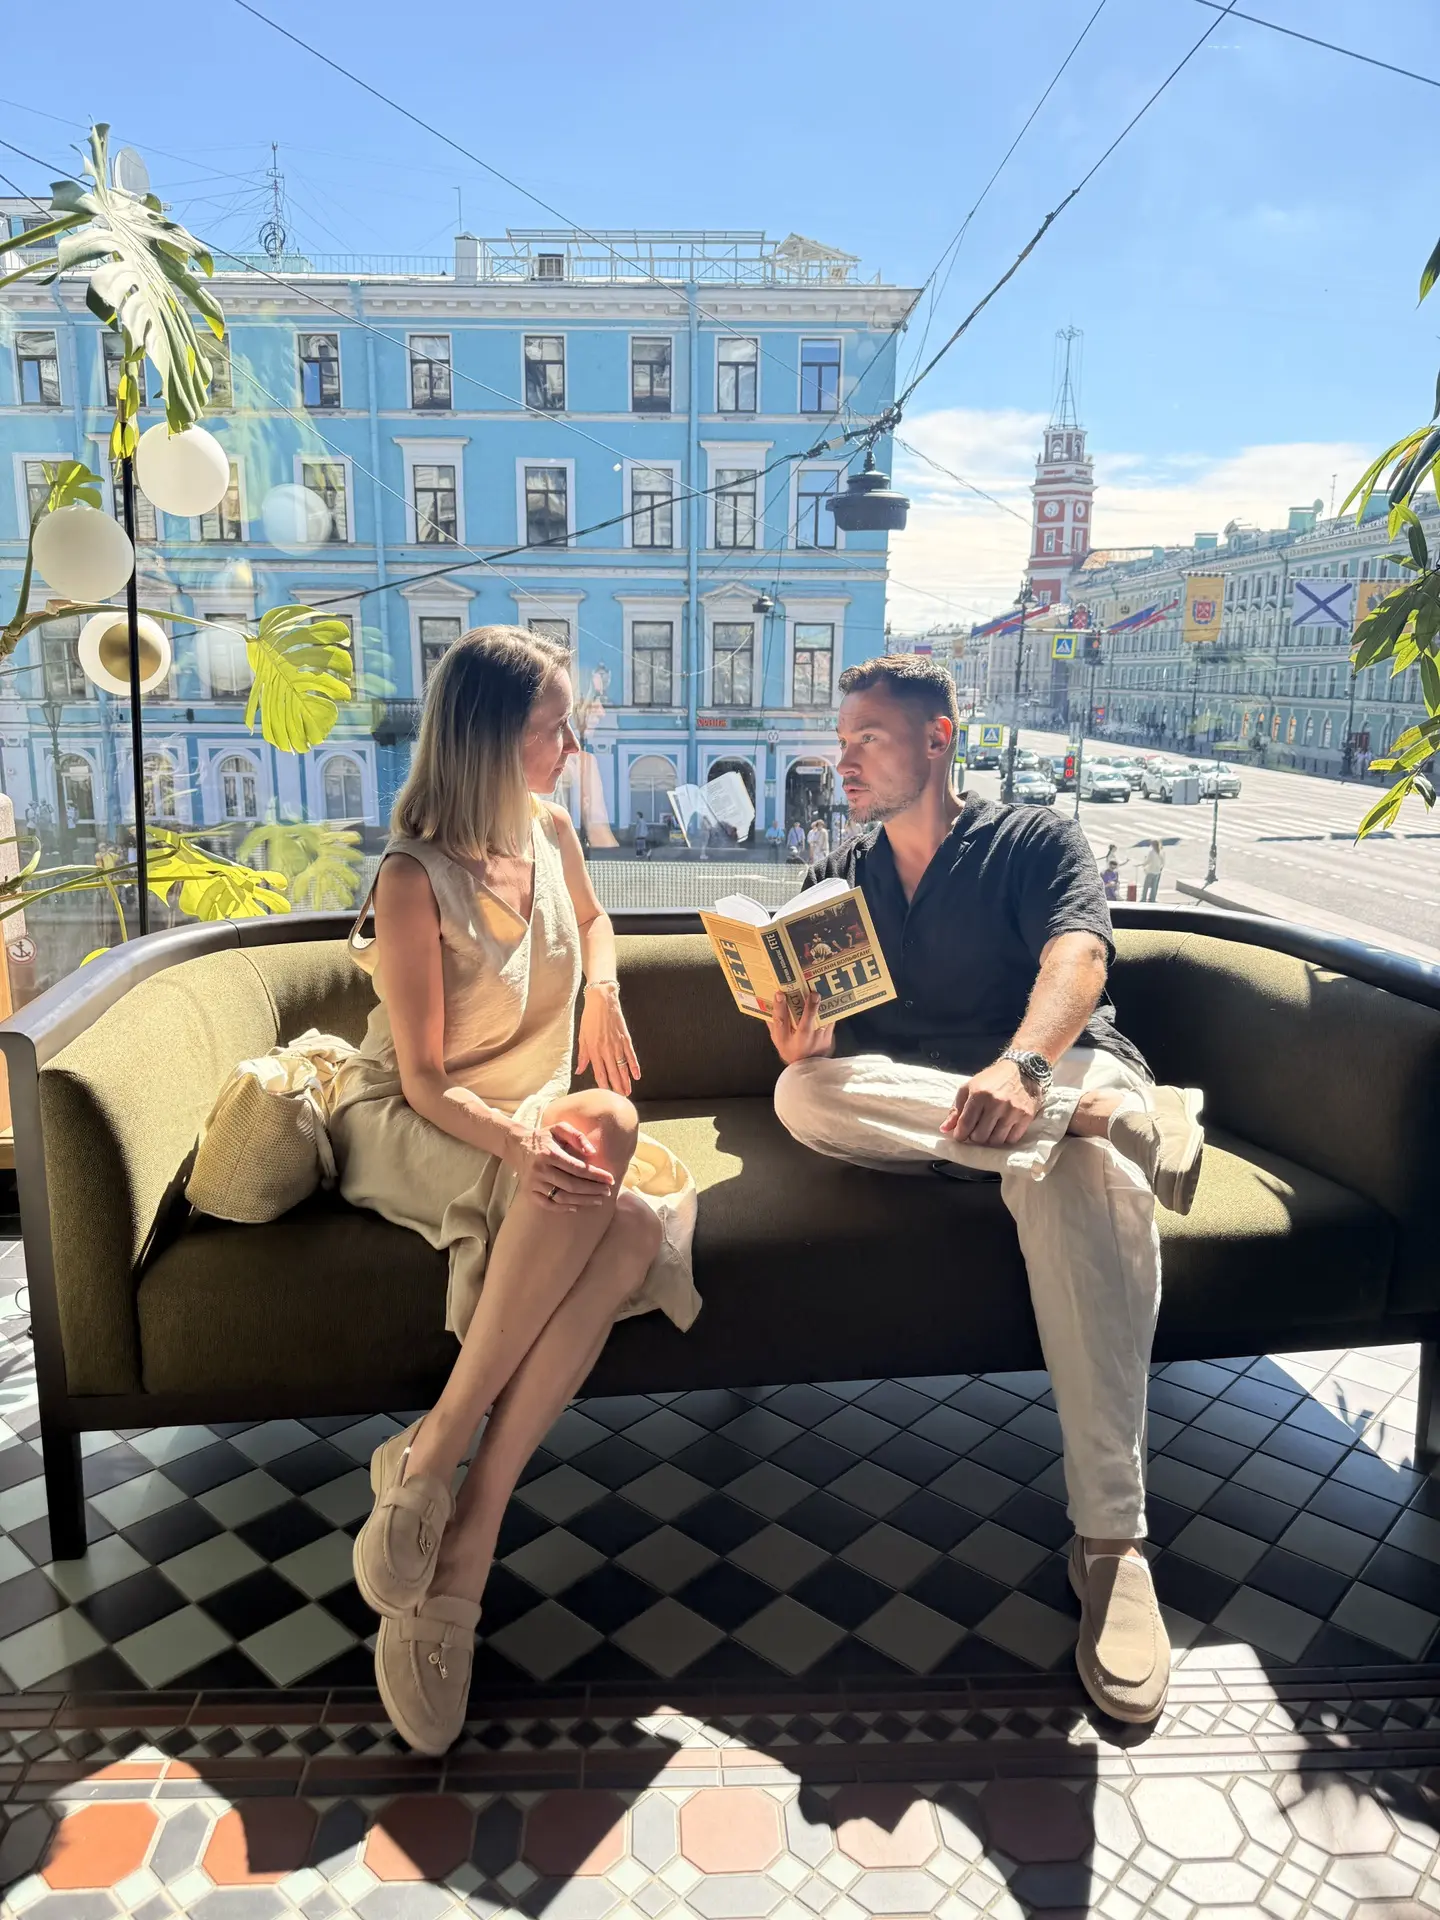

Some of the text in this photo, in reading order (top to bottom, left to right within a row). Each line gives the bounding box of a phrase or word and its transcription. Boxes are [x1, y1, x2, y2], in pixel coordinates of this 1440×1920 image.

[766, 933, 779, 950] ГЕТЕ
[721, 940, 754, 994] ГЕТЕ
[808, 955, 880, 997] ГЕТЕ
[819, 993, 854, 1012] ФАУСТ
